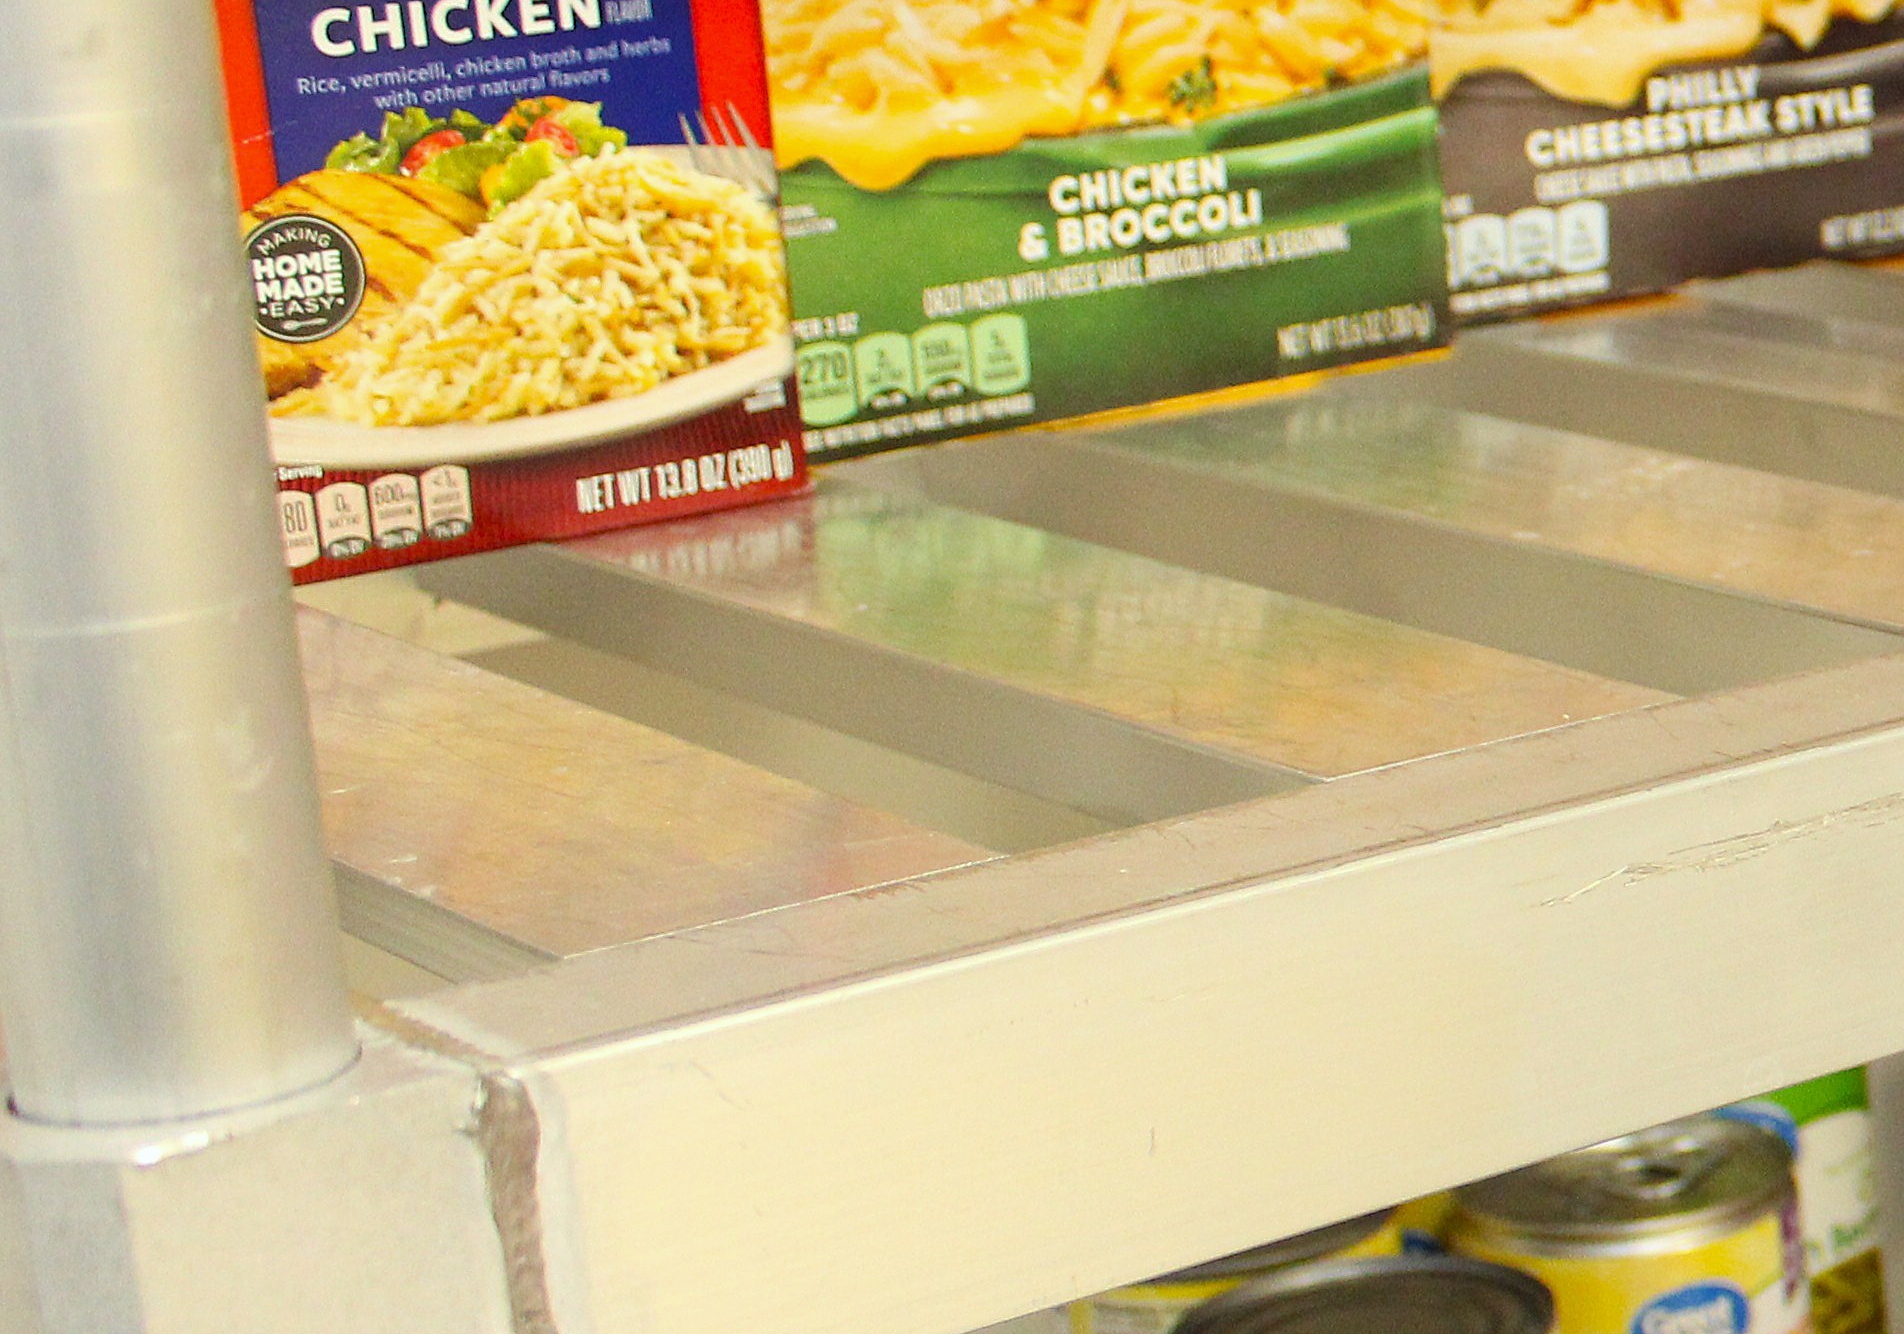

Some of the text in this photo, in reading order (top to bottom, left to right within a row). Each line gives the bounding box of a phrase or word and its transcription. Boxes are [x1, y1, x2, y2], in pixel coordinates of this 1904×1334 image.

[296, 37, 671, 95] Rice, vermicelli, chicken broth and herbs
[374, 69, 610, 110] with other natural flavors
[1646, 64, 1760, 113] PHILLY
[1524, 97, 1772, 167] CHEESESTEAK
[1774, 83, 1876, 133] STYLE
[1048, 153, 1229, 216] CHICKEN
[257, 227, 332, 256] MAKING
[1018, 221, 1051, 263] &
[1055, 186, 1264, 257] BROCCOLI
[252, 248, 342, 281] HOME
[255, 271, 344, 304] MADE
[278, 464, 323, 482] Serving
[576, 473, 615, 514] NET
[616, 467, 651, 507] WT
[699, 453, 729, 492] OZ
